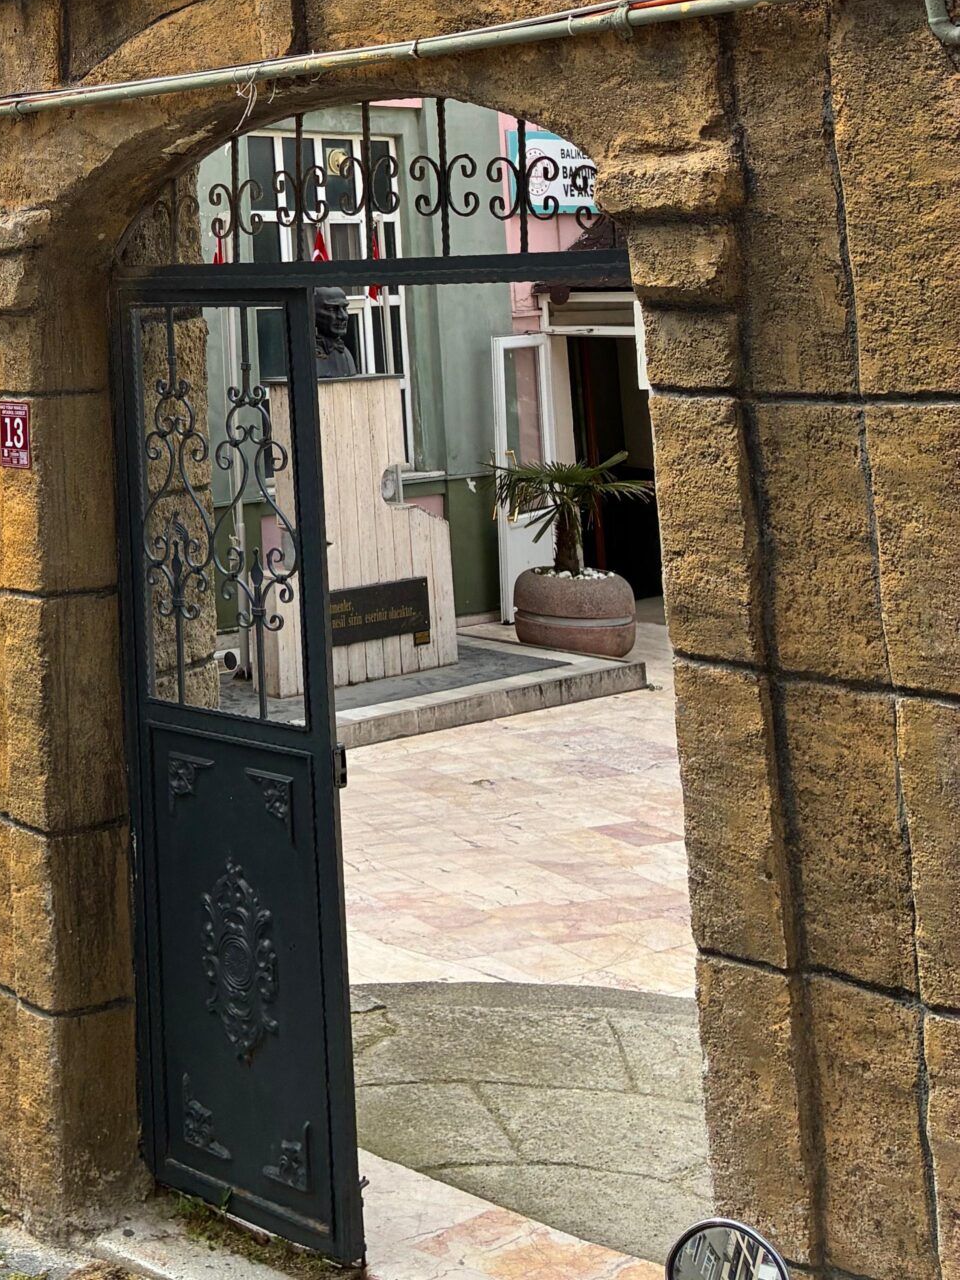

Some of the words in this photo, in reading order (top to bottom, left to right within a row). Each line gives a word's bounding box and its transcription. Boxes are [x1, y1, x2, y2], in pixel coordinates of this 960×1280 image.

[560, 148, 590, 159] BALIK
[563, 184, 575, 197] VE
[4, 417, 24, 448] 13
